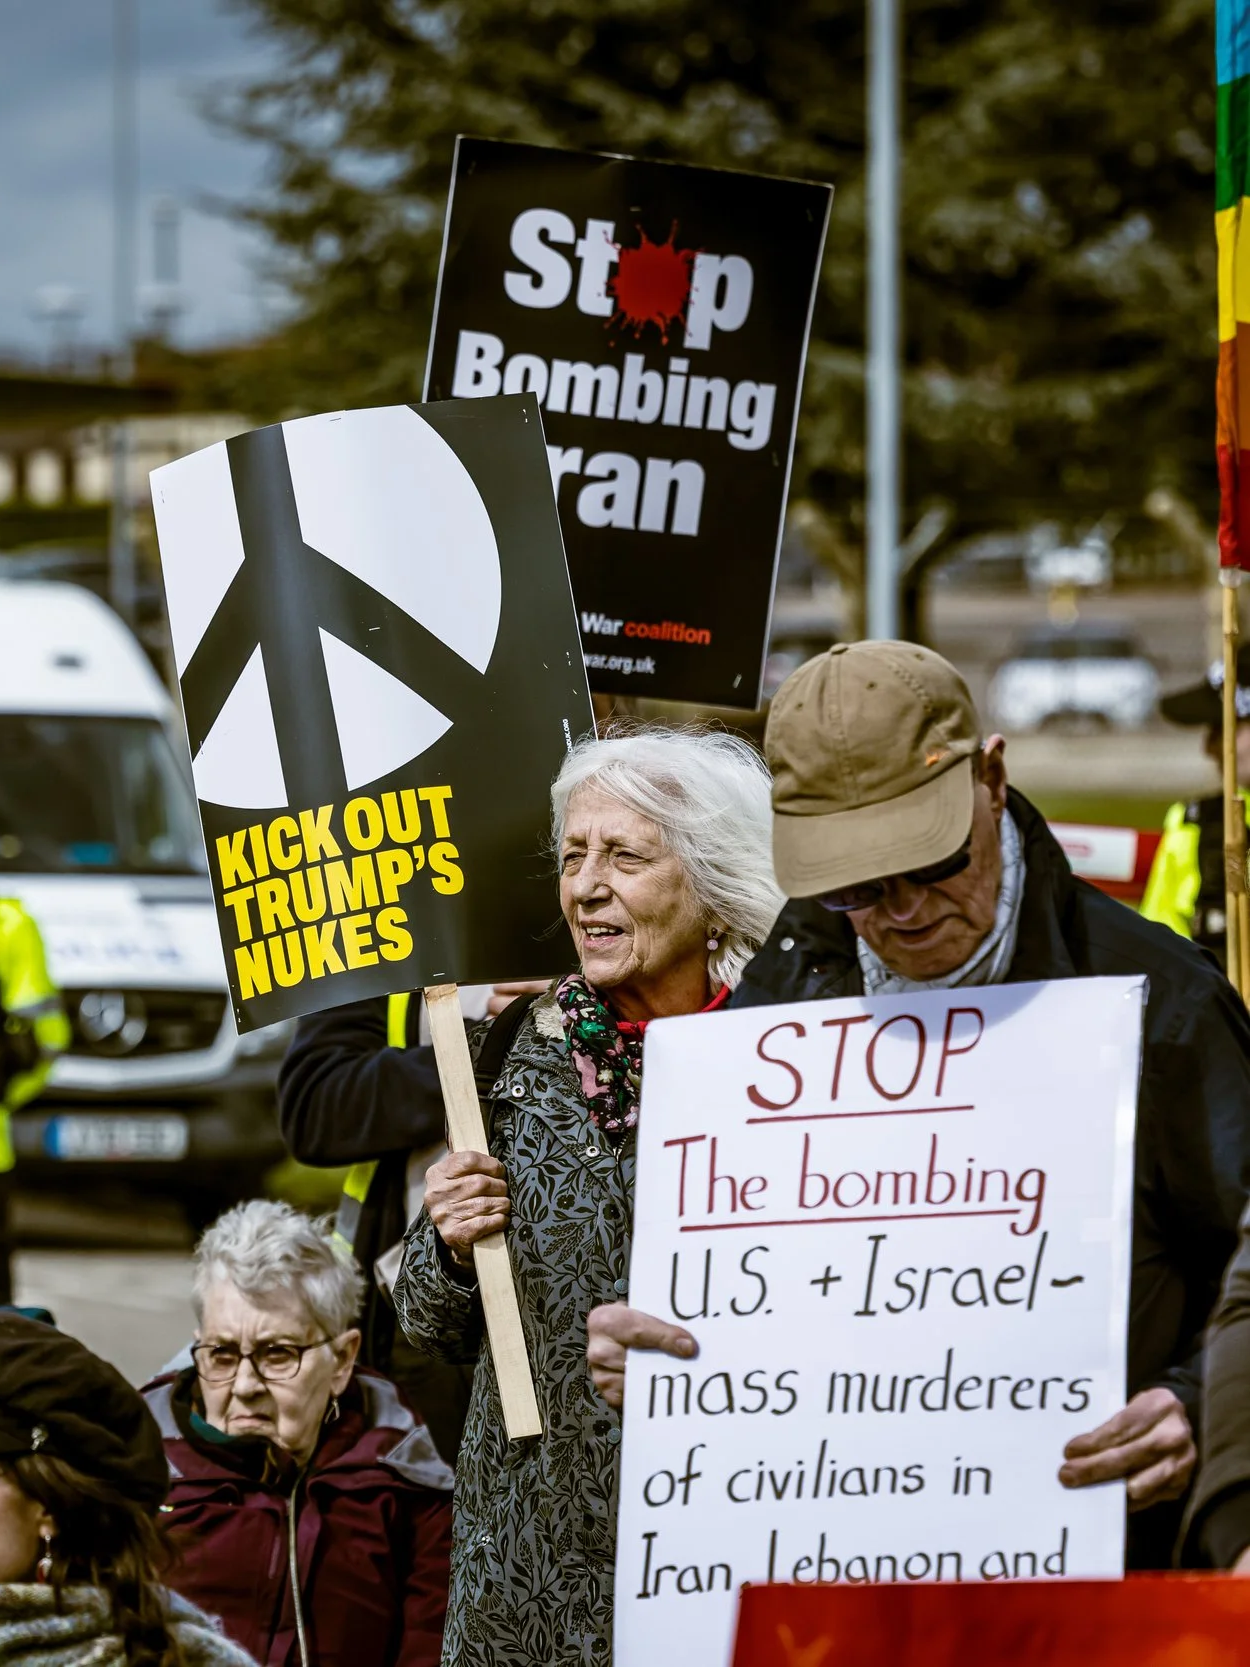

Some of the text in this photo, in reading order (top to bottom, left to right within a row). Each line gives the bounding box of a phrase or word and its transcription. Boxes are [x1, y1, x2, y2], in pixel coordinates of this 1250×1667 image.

[505, 209, 753, 349] Stp
[452, 330, 777, 451] Bombing
[546, 443, 705, 536] ran
[581, 611, 712, 645] War coalition
[584, 653, 656, 675] war.org.uk
[562, 718, 573, 753] CNDUK.ORG
[215, 785, 453, 889] KICK OUT
[222, 842, 465, 943] TRUMP'S
[234, 906, 414, 1001] NUKES
[746, 1006, 985, 1111] STOP
[663, 1132, 1047, 1237] The bombing
[670, 1245, 773, 1321] U.S.
[648, 1347, 1092, 1419] mass murderers
[642, 1439, 992, 1508] of civilians in
[766, 1529, 962, 1586] Lebanon
[979, 1527, 1068, 1581] and
